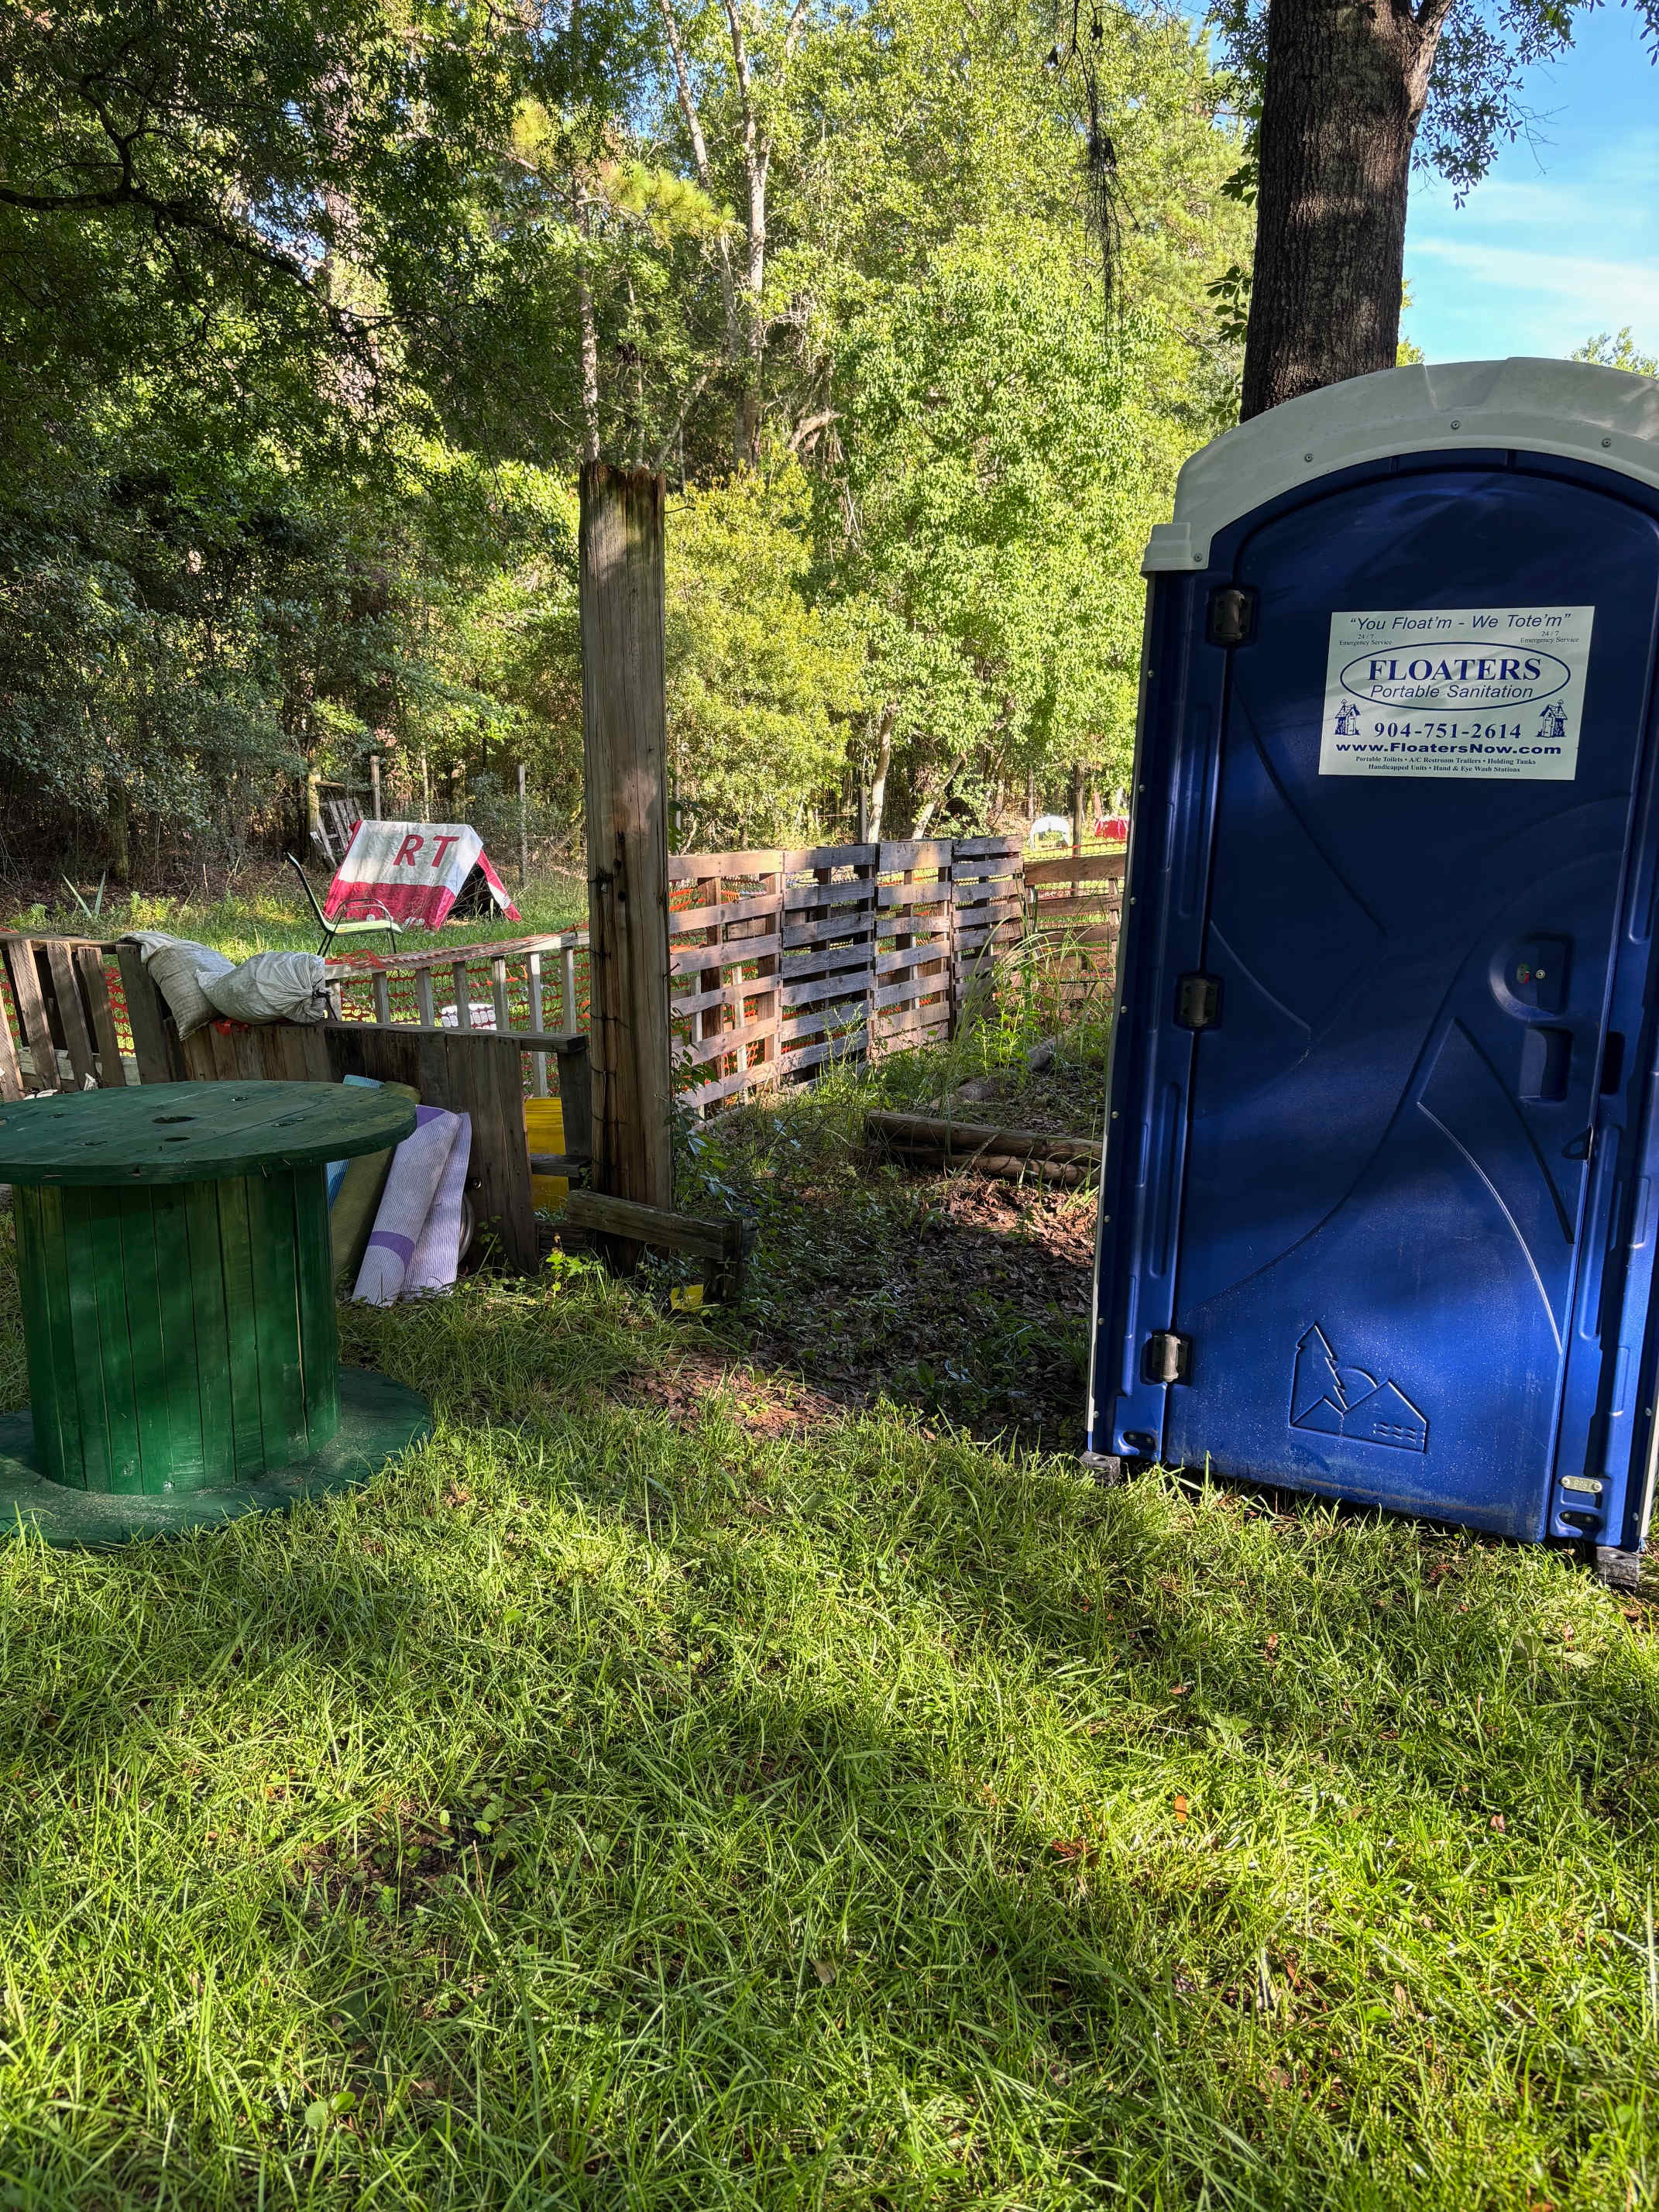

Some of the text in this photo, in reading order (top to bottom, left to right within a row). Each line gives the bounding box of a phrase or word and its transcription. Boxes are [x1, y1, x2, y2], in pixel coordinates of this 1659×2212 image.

[1472, 615, 1498, 628] We
[1367, 658, 1541, 681] FLOATERS
[1370, 685, 1534, 698] Portable Sanitation
[1374, 722, 1522, 739] 904-751-2614
[1335, 742, 1561, 754] www.FloatersNow.com
